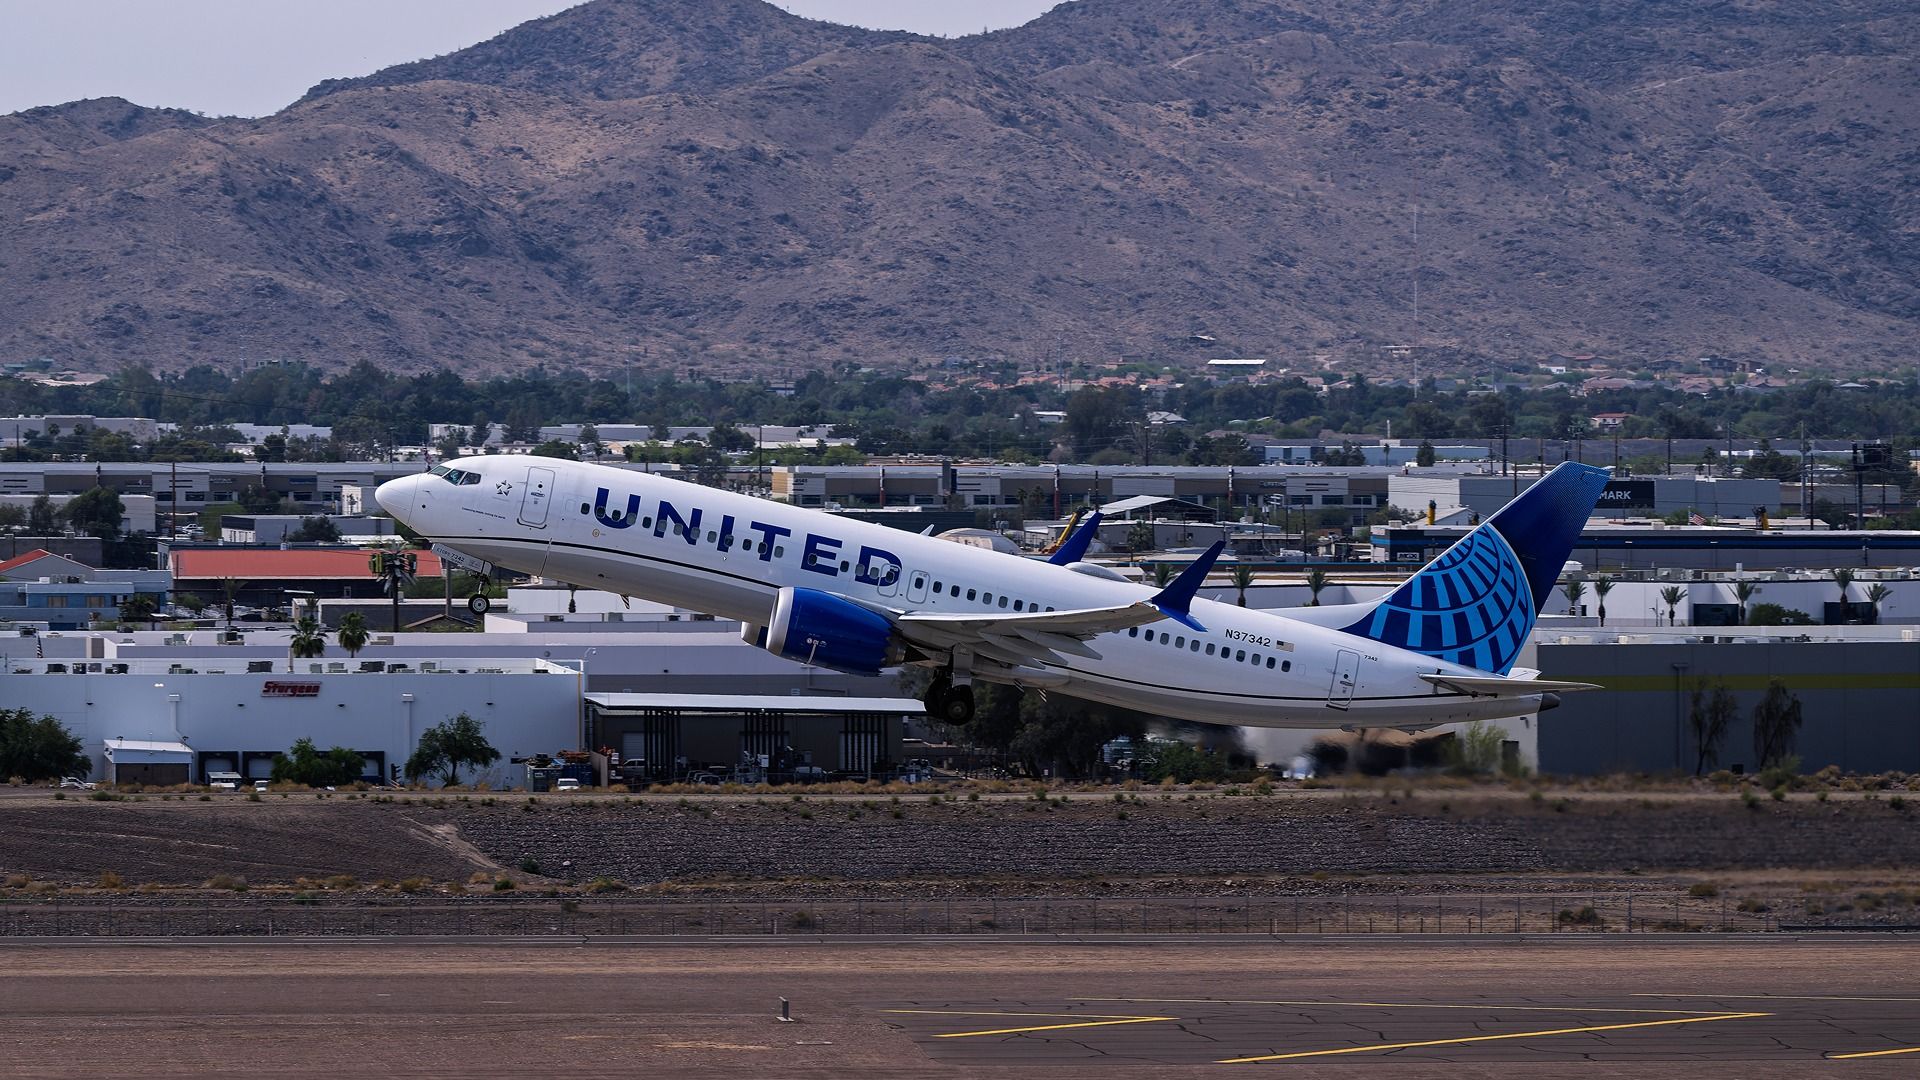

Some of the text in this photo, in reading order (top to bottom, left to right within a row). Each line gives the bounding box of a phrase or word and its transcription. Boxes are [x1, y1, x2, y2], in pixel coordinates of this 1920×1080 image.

[1600, 490, 1632, 500] MARK
[593, 487, 903, 587] UNITED
[451, 551, 466, 562] 7342
[1225, 628, 1271, 648] N37342
[1364, 654, 1378, 662] 7342
